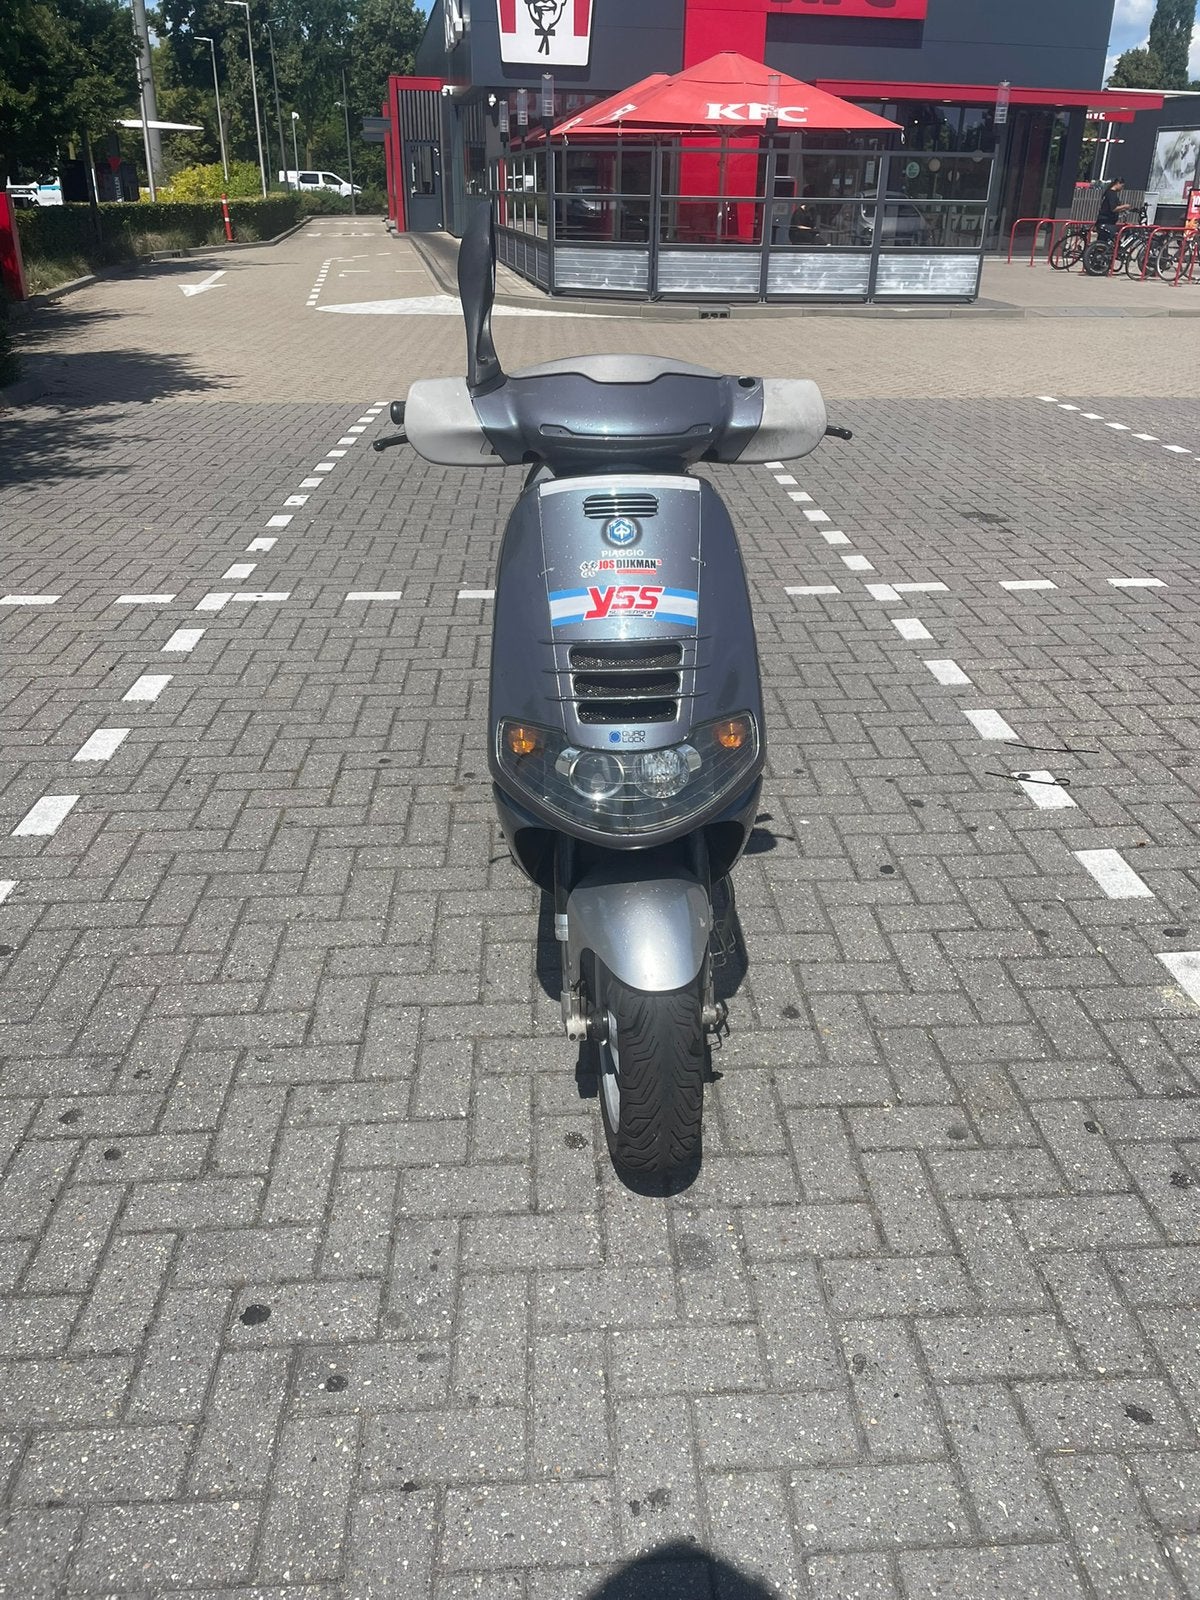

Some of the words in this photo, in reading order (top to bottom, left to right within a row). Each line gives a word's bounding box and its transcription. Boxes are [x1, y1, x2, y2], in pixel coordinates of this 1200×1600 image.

[704, 102, 808, 123] KFC
[601, 549, 644, 557] PIAGGIO
[599, 560, 615, 569] JOS
[616, 559, 656, 569] DIJKMAN
